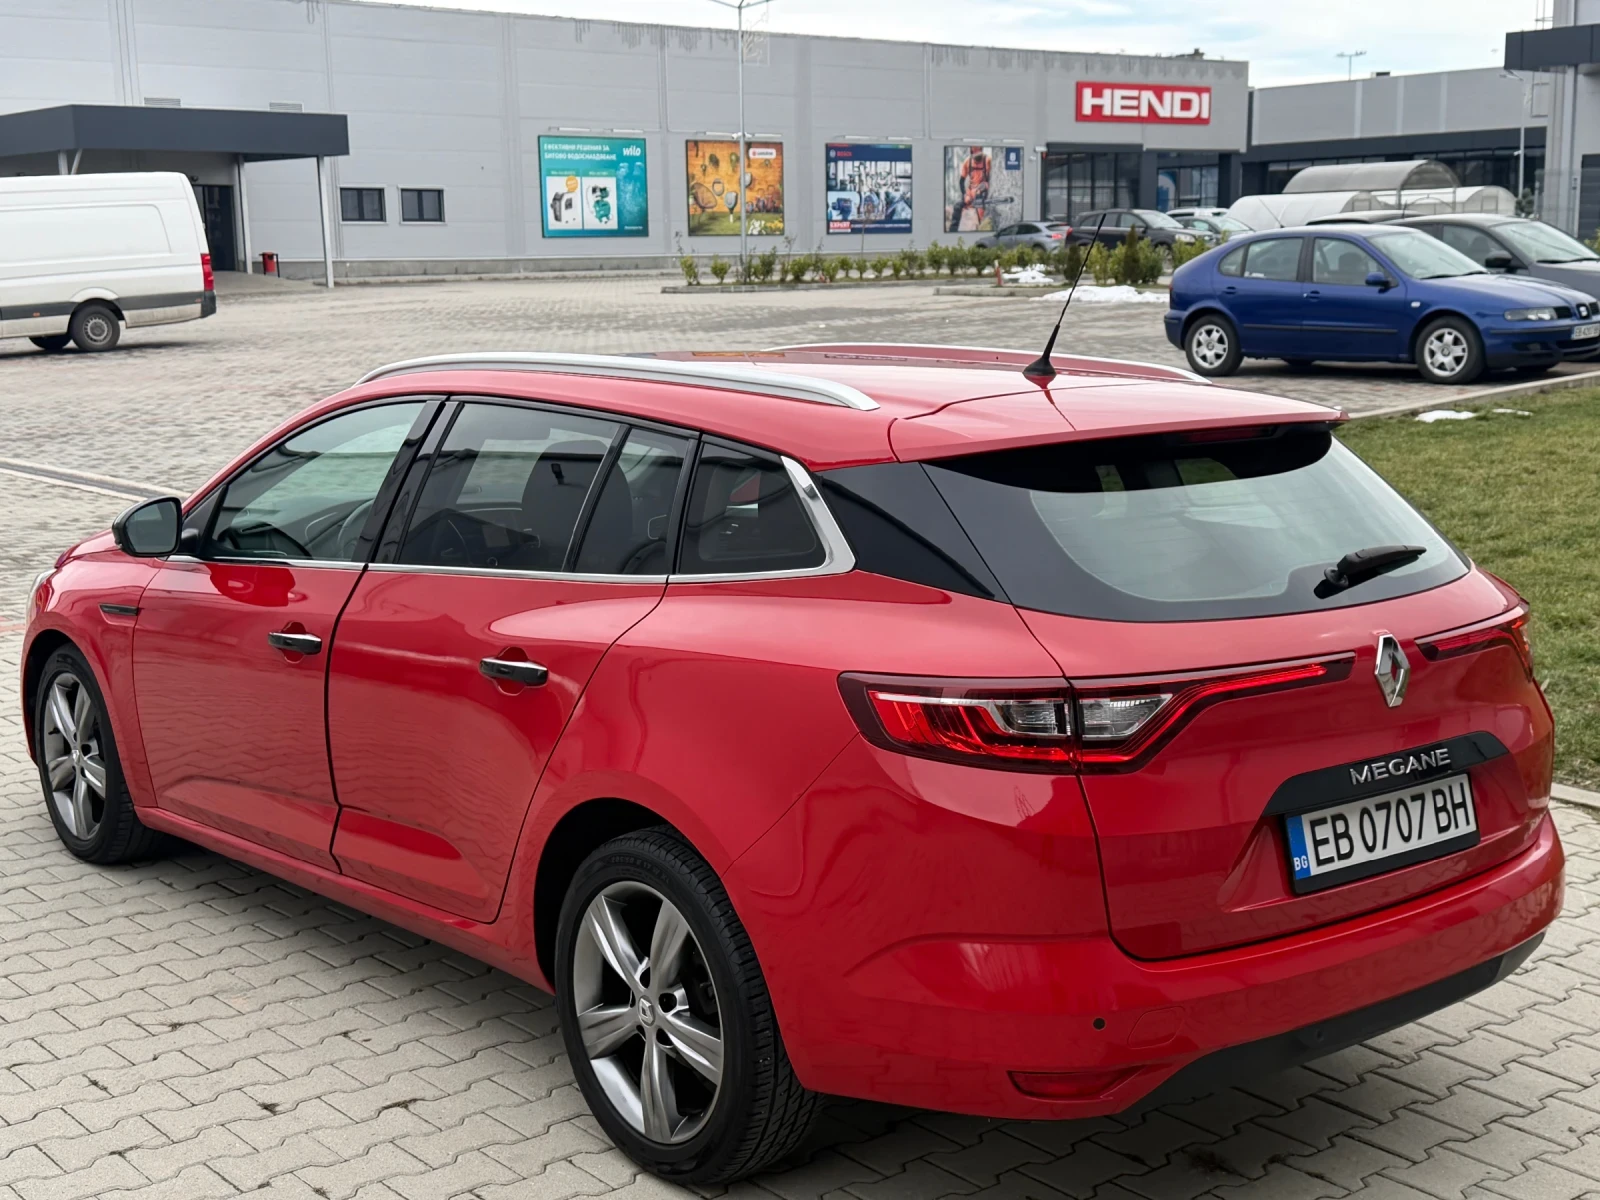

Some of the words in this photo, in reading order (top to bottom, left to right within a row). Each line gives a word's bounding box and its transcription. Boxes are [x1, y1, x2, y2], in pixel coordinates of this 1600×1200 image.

[1081, 87, 1210, 119] HENDI
[622, 145, 641, 157] wilo
[1349, 748, 1451, 785] MEGANE
[1309, 813, 1354, 867] EB
[1359, 793, 1426, 853] 0707
[1431, 782, 1471, 835] BH
[1293, 855, 1308, 871] BG
